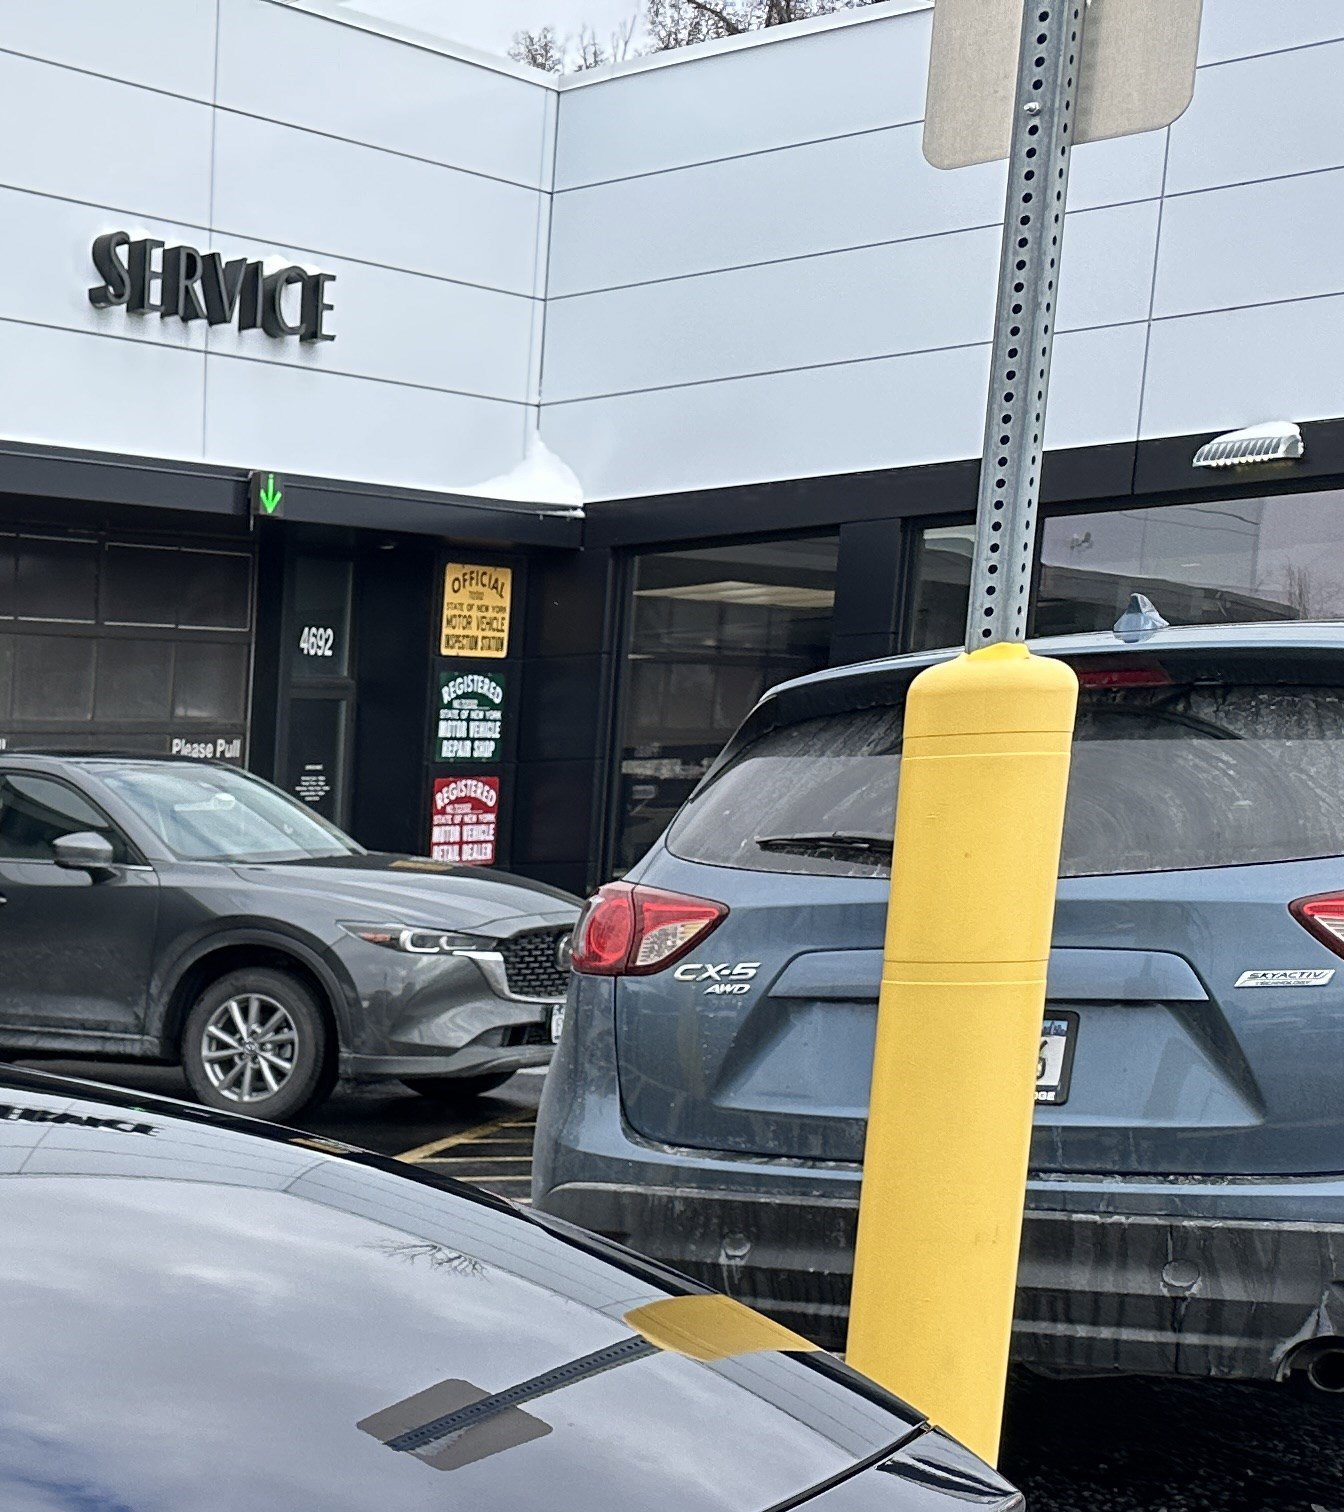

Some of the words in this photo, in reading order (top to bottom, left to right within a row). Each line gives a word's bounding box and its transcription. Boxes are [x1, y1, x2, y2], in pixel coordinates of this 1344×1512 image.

[88, 231, 337, 342] SERVICE
[451, 570, 505, 599] OFFICIAL
[446, 602, 464, 612] STATE
[466, 603, 474, 612] OF
[476, 604, 489, 613] NEW
[446, 614, 472, 630] MOTOR
[476, 615, 506, 632] VEHICLE
[299, 626, 334, 656] 4692
[444, 634, 479, 650] INSPECTION
[480, 635, 504, 651] STATION
[441, 674, 503, 704] REGISTERED
[438, 720, 467, 738] MOTOR
[469, 721, 501, 739] VEHICLE
[172, 737, 213, 758] Please
[215, 738, 241, 758] Pull
[441, 740, 471, 757] REPAIR
[473, 740, 495, 757] SHOP
[435, 779, 496, 810] REGISTERED
[673, 962, 762, 981] CX-5
[1247, 971, 1325, 979] SKYACTIV
[703, 983, 751, 995] AWD
